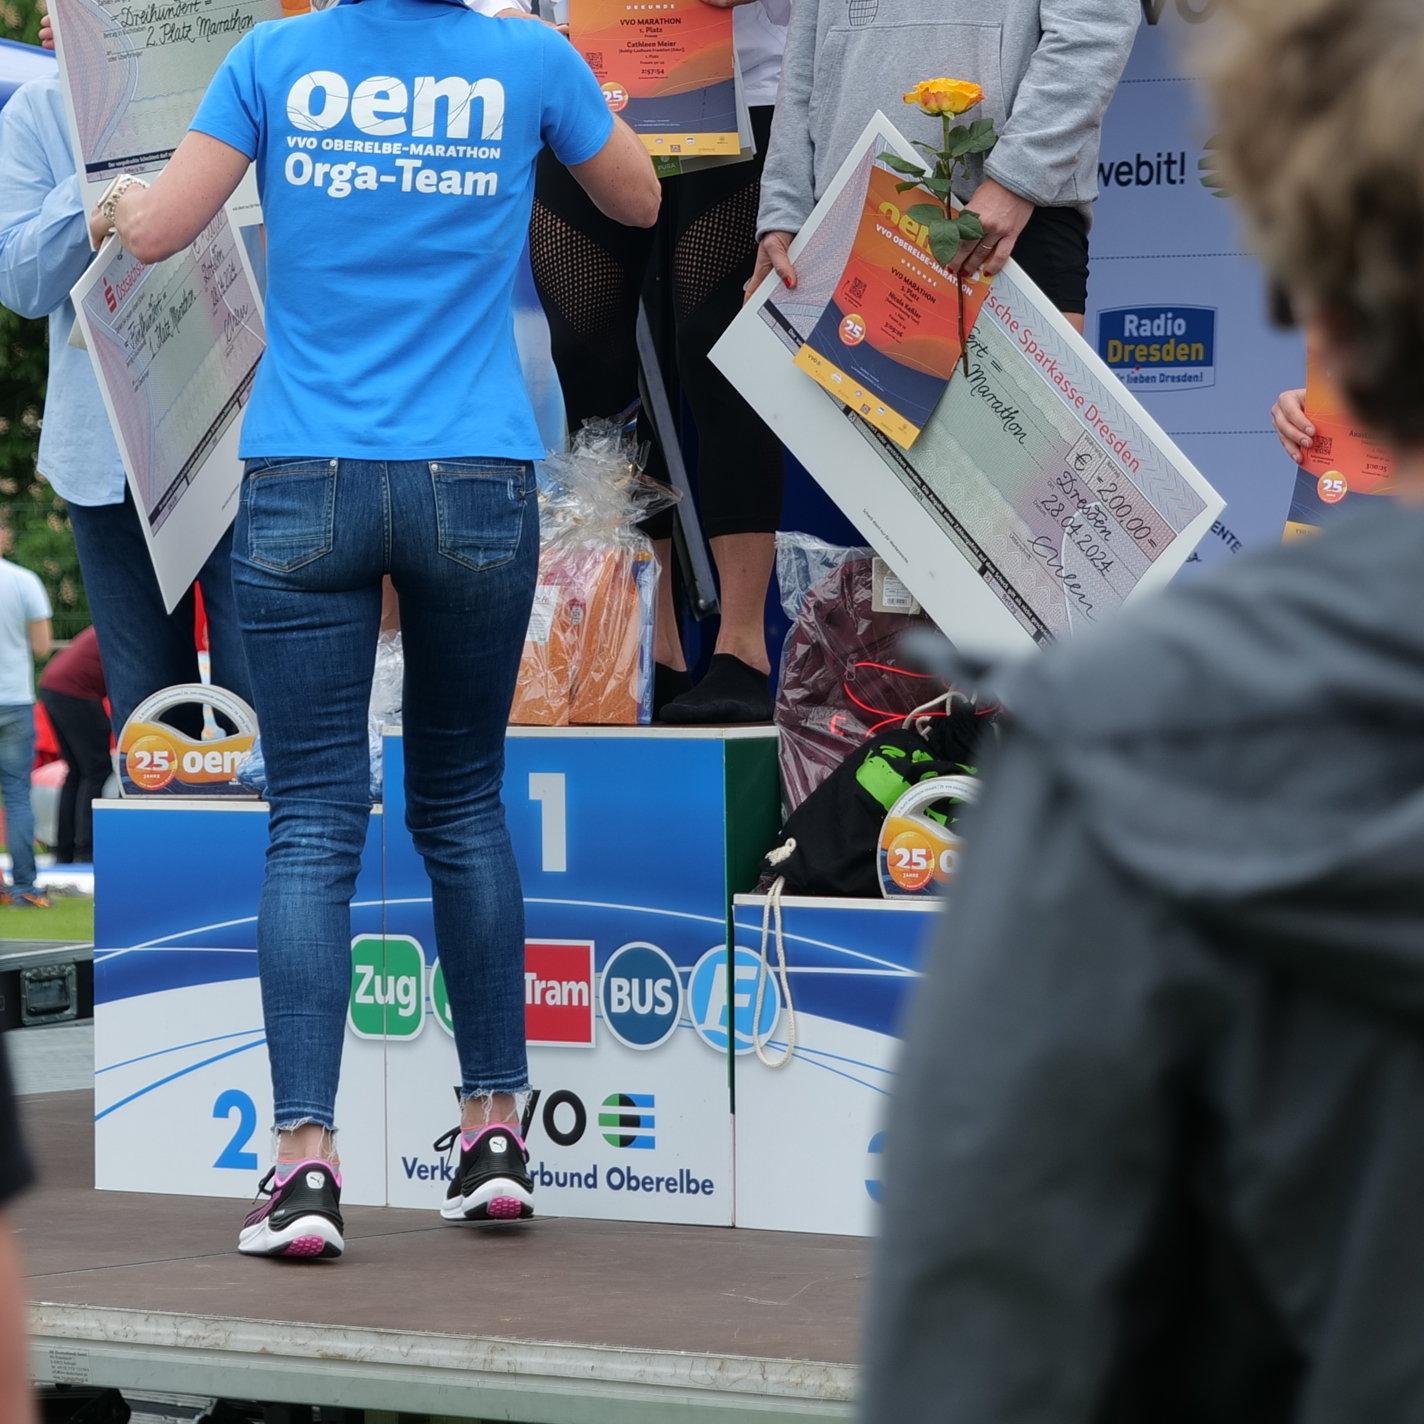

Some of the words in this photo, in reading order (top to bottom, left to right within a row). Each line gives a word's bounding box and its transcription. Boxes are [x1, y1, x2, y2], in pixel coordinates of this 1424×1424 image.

[637, 17, 682, 26] MARATHON
[286, 70, 506, 142] oem
[286, 136, 318, 151] VVO
[321, 137, 501, 160] OBERELBE-MARATHON
[284, 153, 498, 198] Orga-Team
[876, 223, 893, 240] VVO
[891, 267, 903, 281] VVO
[902, 275, 937, 305] MARATHON
[843, 319, 863, 339] 25
[1124, 312, 1187, 338] Radio
[1107, 339, 1204, 364] Dresden
[1159, 372, 1204, 384] Dresden!
[1018, 328, 1085, 410] Sparkasse
[1084, 404, 1140, 474] Dresden
[1322, 479, 1343, 493] 25
[134, 750, 170, 772] 25
[529, 773, 567, 873] 1
[894, 847, 927, 870] 25
[354, 964, 417, 1017] Zug
[610, 977, 673, 1016] BUS
[214, 1090, 258, 1171] 2
[605, 1168, 715, 1197] Oberelbe
